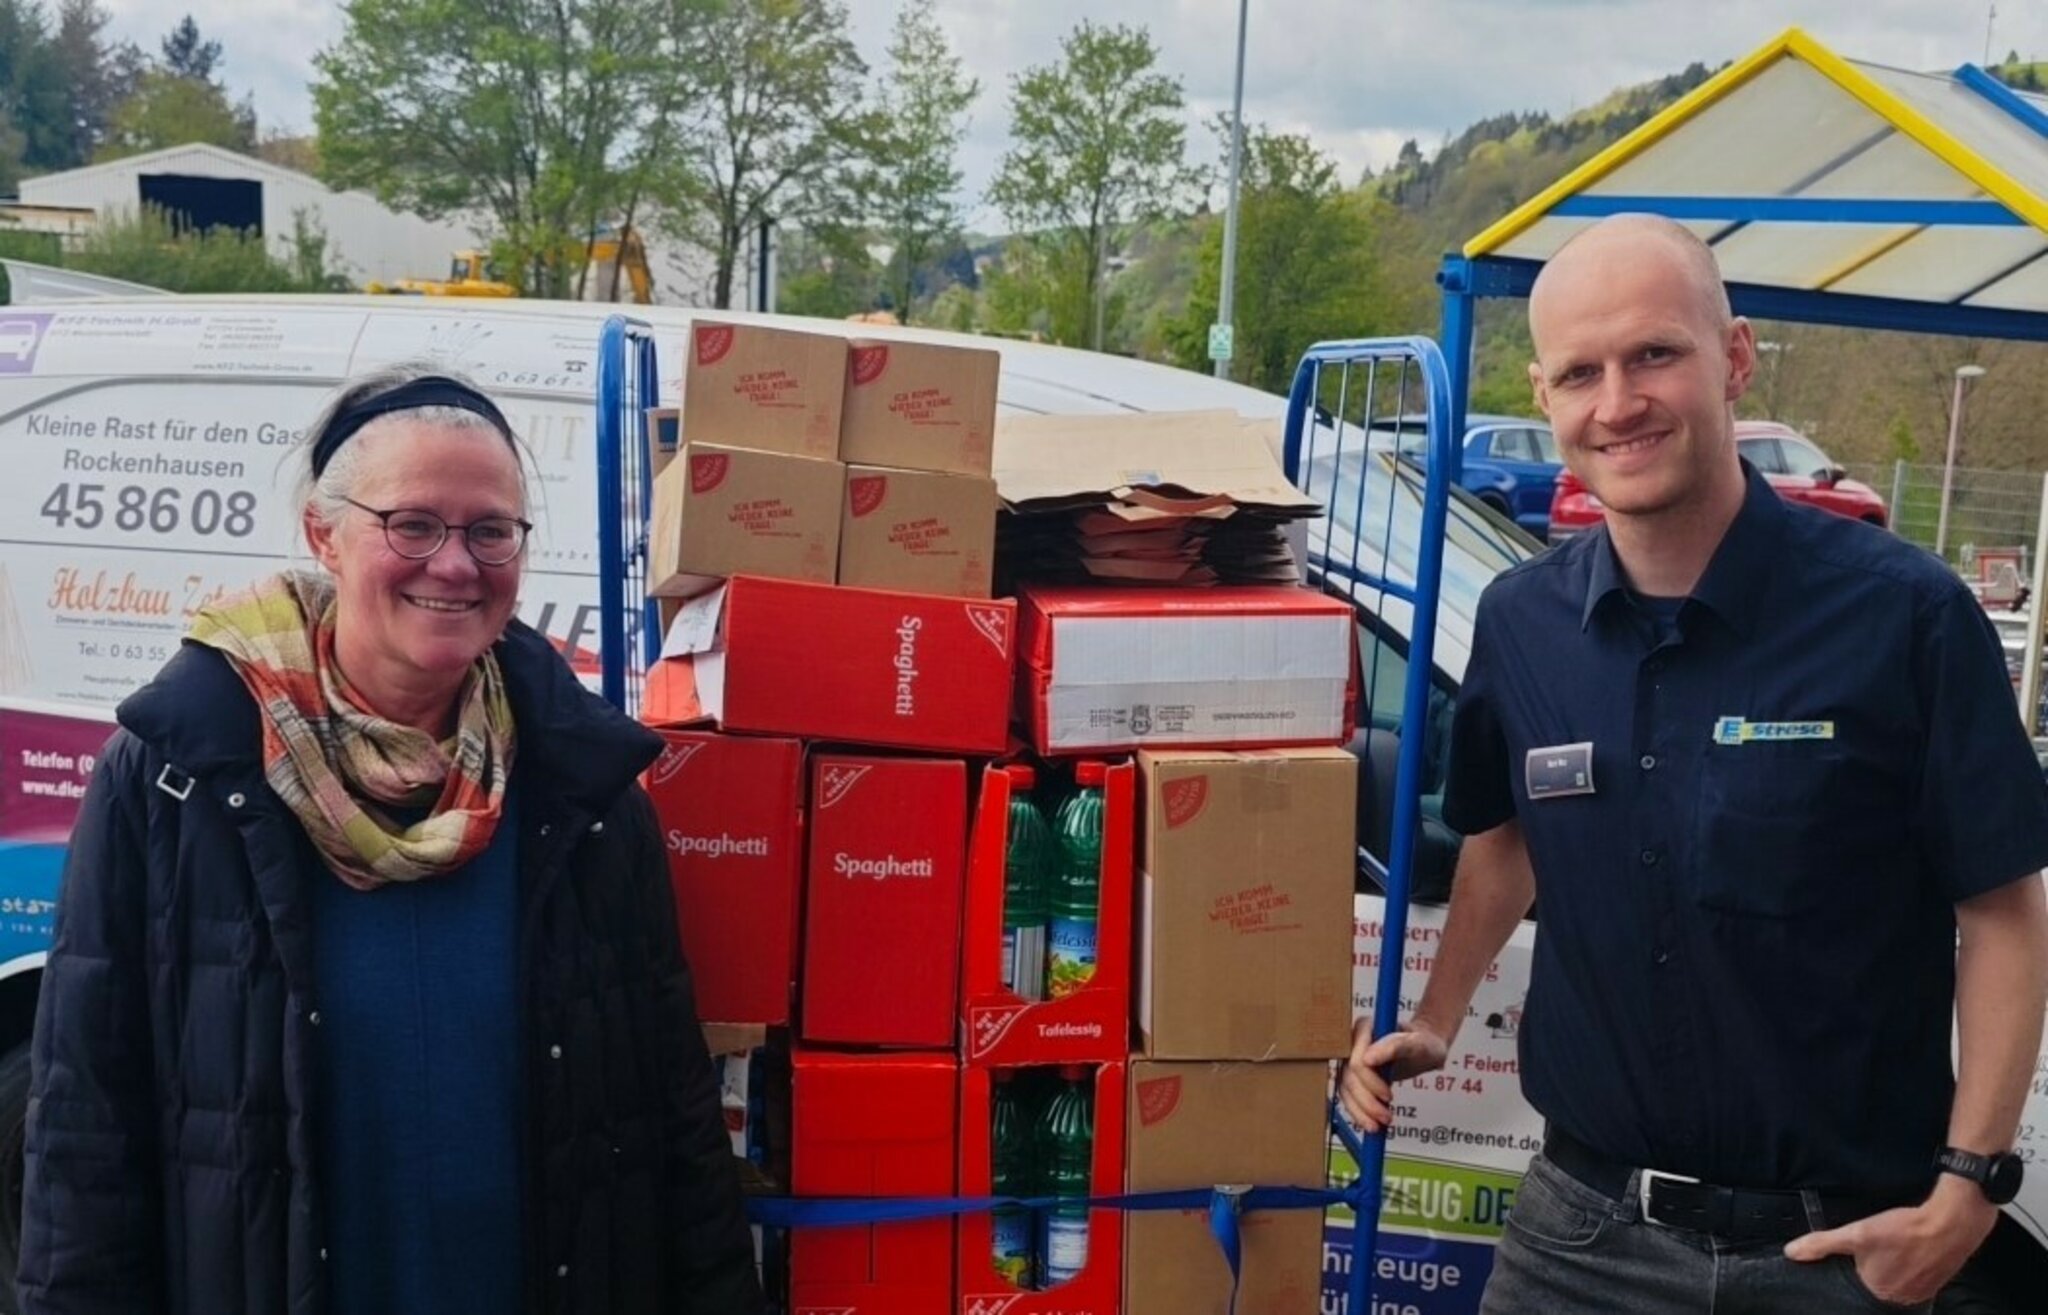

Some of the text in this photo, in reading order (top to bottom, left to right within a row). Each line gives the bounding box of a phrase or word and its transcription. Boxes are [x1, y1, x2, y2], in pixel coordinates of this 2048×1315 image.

[26, 413, 97, 437] Kleine
[103, 416, 156, 441] Rast
[163, 418, 196, 442] für
[203, 420, 249, 444] den
[62, 448, 245, 478] Rockenhausen
[40, 482, 257, 538] 45 86 08
[47, 566, 171, 615] Holzbau
[109, 643, 121, 658] 0
[124, 645, 143, 660] 63
[148, 646, 167, 662] 55
[893, 614, 923, 716] Spaghetti
[22, 750, 74, 770] Telefon
[666, 828, 769, 859] Spaghetti
[833, 851, 933, 882] Spaghetti
[1215, 883, 1273, 908] ICH KOMM
[1037, 1022, 1102, 1038] Tafelessig
[1435, 1075, 1456, 1092] 87
[1460, 1078, 1483, 1094] 44
[1388, 1103, 1418, 1119] enz
[1386, 1124, 1542, 1152] gung@freenet.de
[1382, 1173, 1514, 1227] ZEUG.DE
